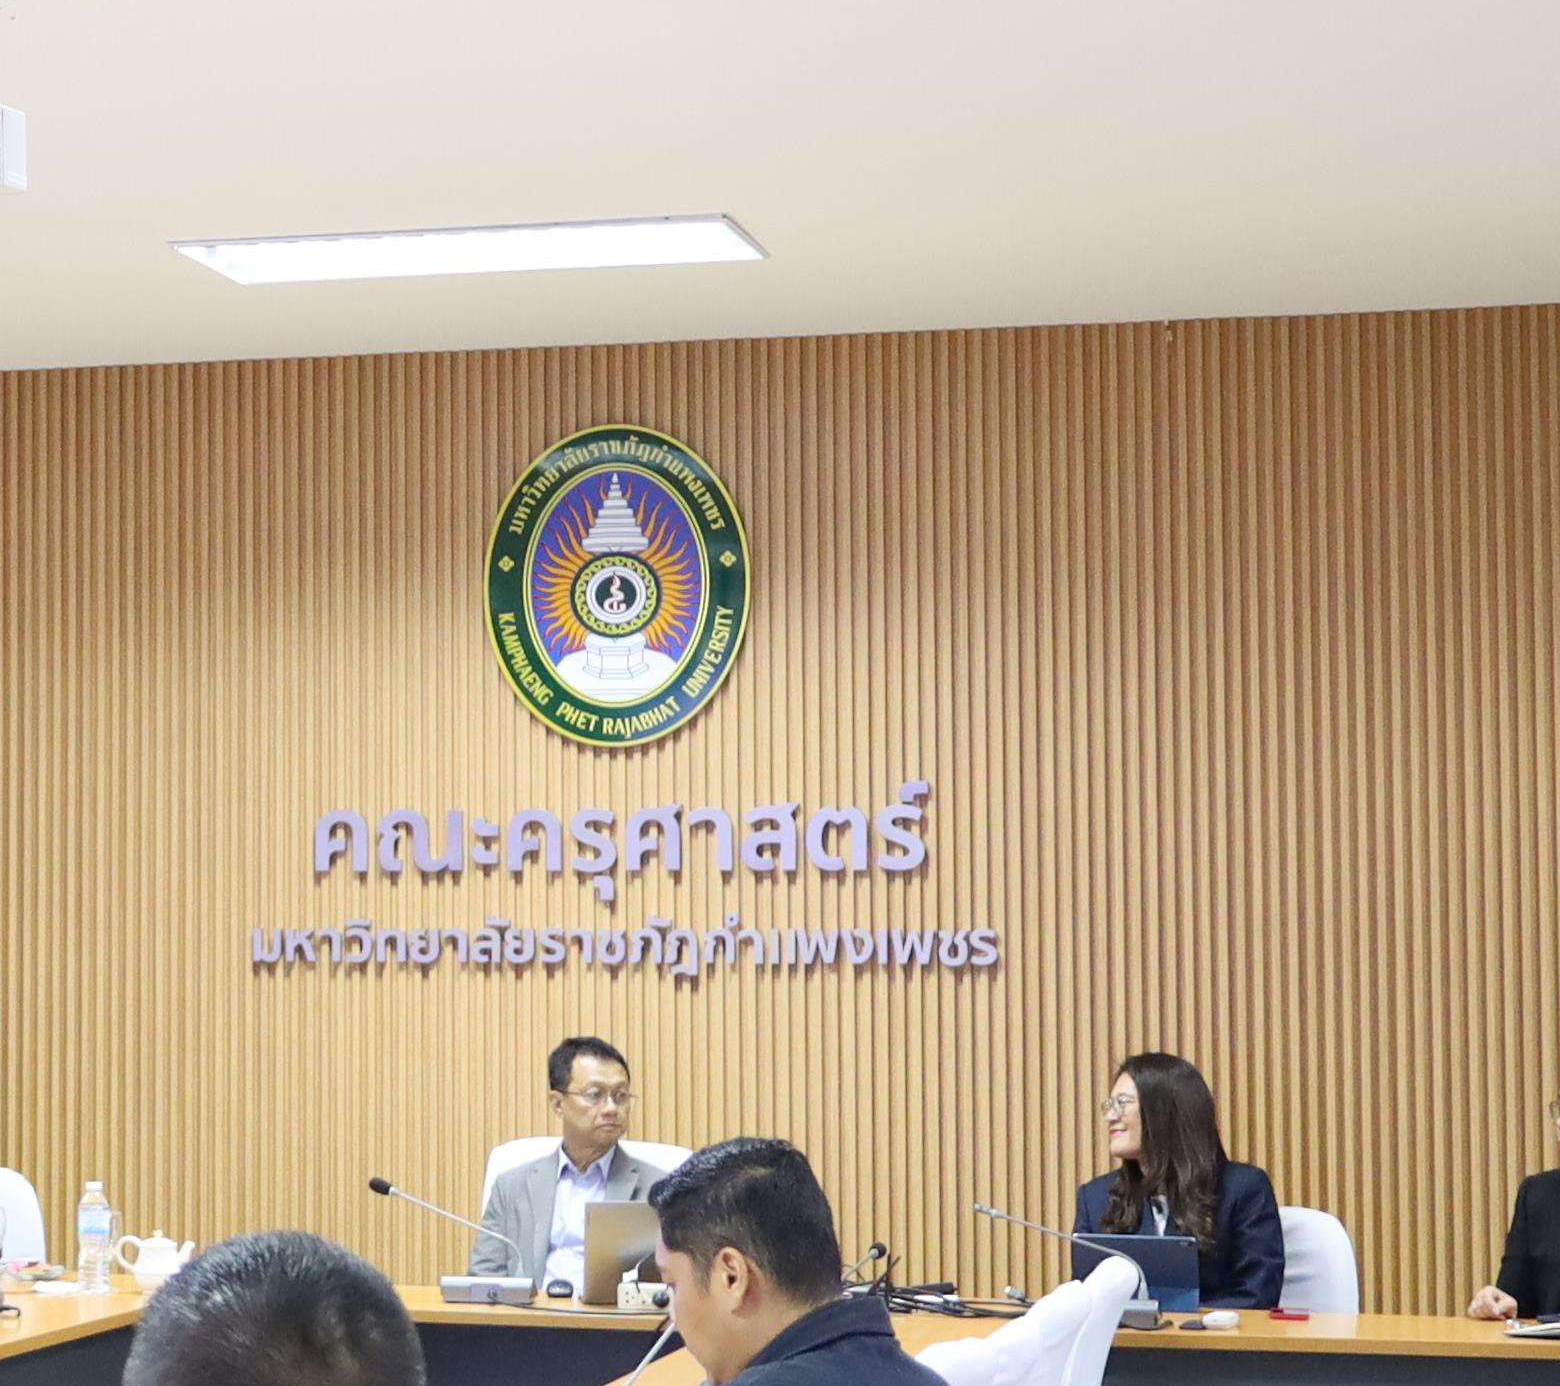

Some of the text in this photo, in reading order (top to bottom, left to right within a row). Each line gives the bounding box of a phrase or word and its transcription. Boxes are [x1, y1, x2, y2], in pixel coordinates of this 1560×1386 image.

[498, 604, 734, 738] KAMPHAENG PHET RAJABHAT UNIVERSITY
[313, 780, 930, 902] คณะครุศาสตร์
[251, 913, 1000, 977] มหาวิทยาลัยราชภัฏกำแพงเพชร
